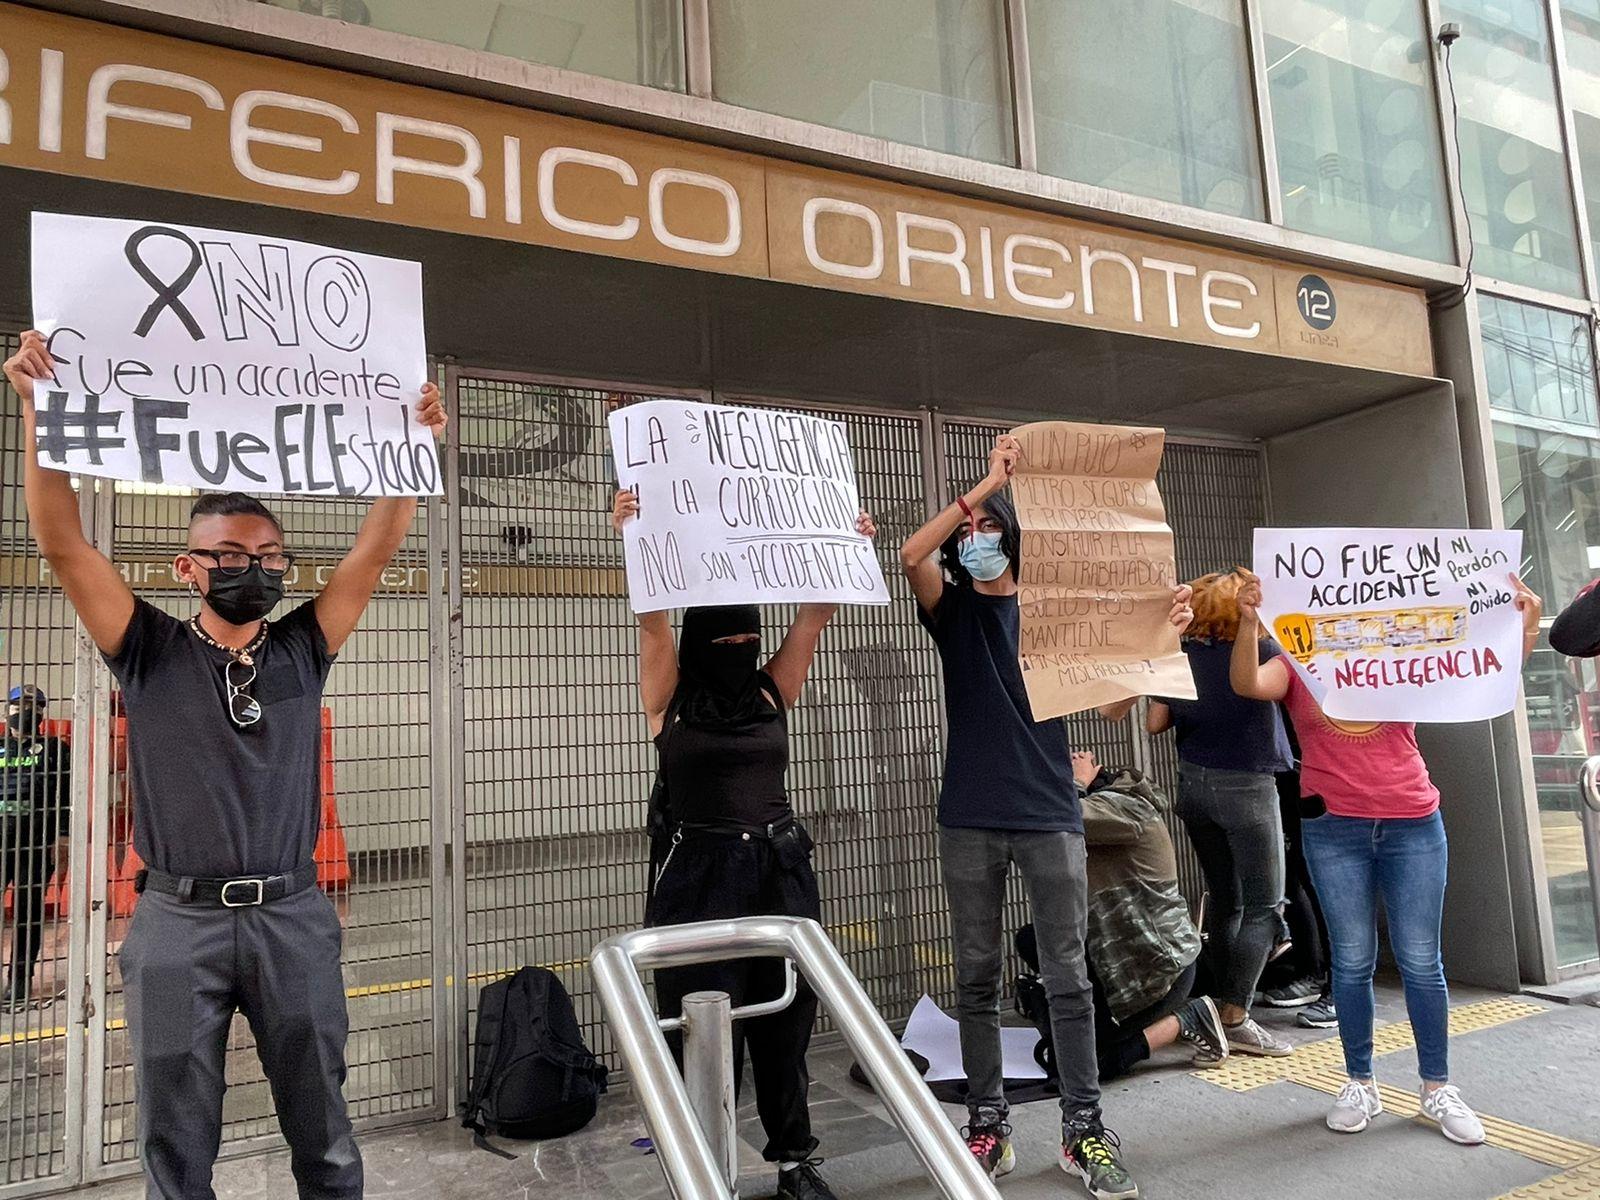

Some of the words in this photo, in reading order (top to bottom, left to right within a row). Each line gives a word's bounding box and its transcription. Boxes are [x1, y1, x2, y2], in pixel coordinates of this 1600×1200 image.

[0, 48, 742, 256] IFERICO
[803, 197, 1260, 339] ORIENTE
[200, 241, 370, 351] NO
[1298, 287, 1332, 320] 12
[174, 363, 226, 395] un
[237, 354, 400, 400] accidente
[625, 416, 669, 468] LA
[704, 410, 855, 485] NEGLIGENCIA
[1041, 430, 1067, 471] UN
[1073, 431, 1122, 474] PUTO
[672, 478, 699, 514] LA
[1015, 476, 1075, 508] METRO
[1081, 478, 1148, 508] SEGURO
[1022, 531, 1102, 557] CONSTRUIR
[1110, 532, 1121, 557] A
[1128, 532, 1148, 557] LA
[1275, 543, 1324, 579] NO
[1341, 544, 1395, 578] FUE
[1406, 537, 1441, 571] UN
[1451, 536, 1473, 554] NI
[638, 531, 687, 597] NO
[700, 551, 738, 582] SON
[1021, 561, 1060, 585] CLASE
[1073, 560, 1175, 588] TRABAJADORA
[1308, 570, 1440, 608] ACCIDENTE
[1466, 581, 1487, 598] NI
[1335, 647, 1502, 688] NEGLIGENCIA
